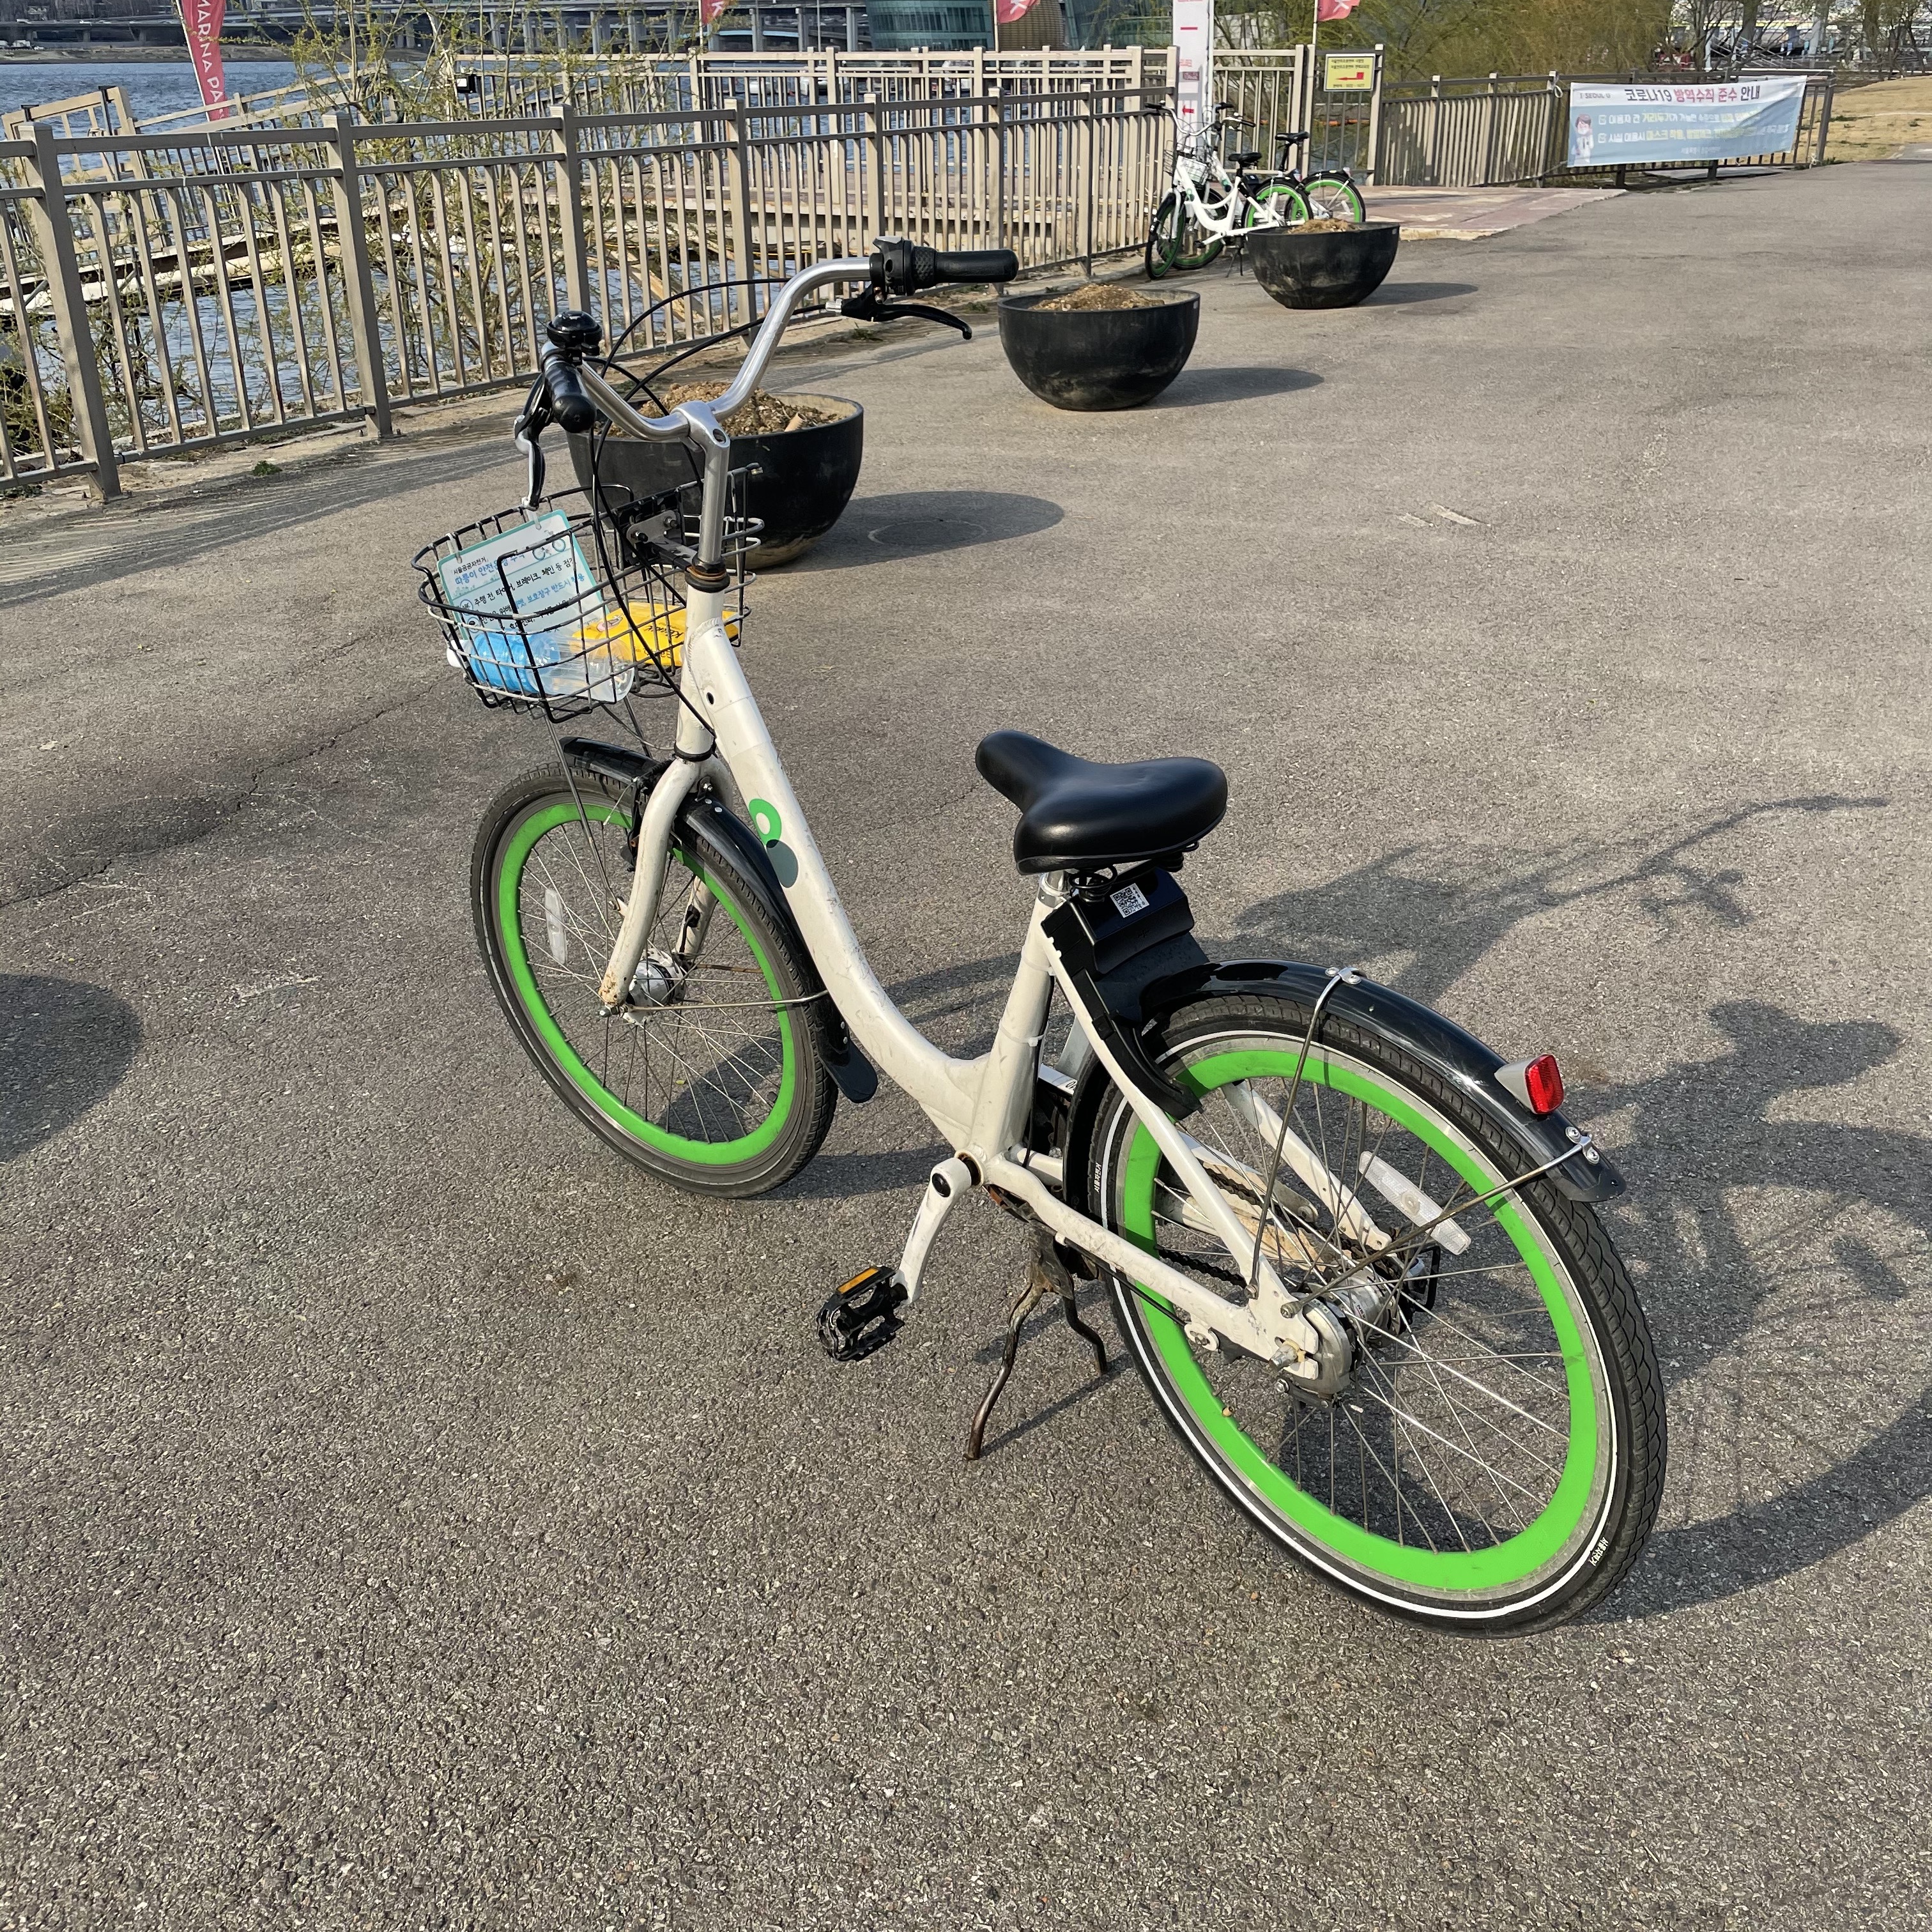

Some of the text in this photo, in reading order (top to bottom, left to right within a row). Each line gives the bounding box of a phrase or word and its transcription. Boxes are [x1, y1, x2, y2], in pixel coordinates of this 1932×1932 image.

[1625, 85, 1760, 103] 코로나19 방역수칙 준수 안내
[455, 570, 477, 585] 따릉이
[475, 595, 487, 606] 주행
[555, 562, 562, 571] 등
[527, 588, 551, 603] 보호장구
[551, 579, 571, 592] 반드시
